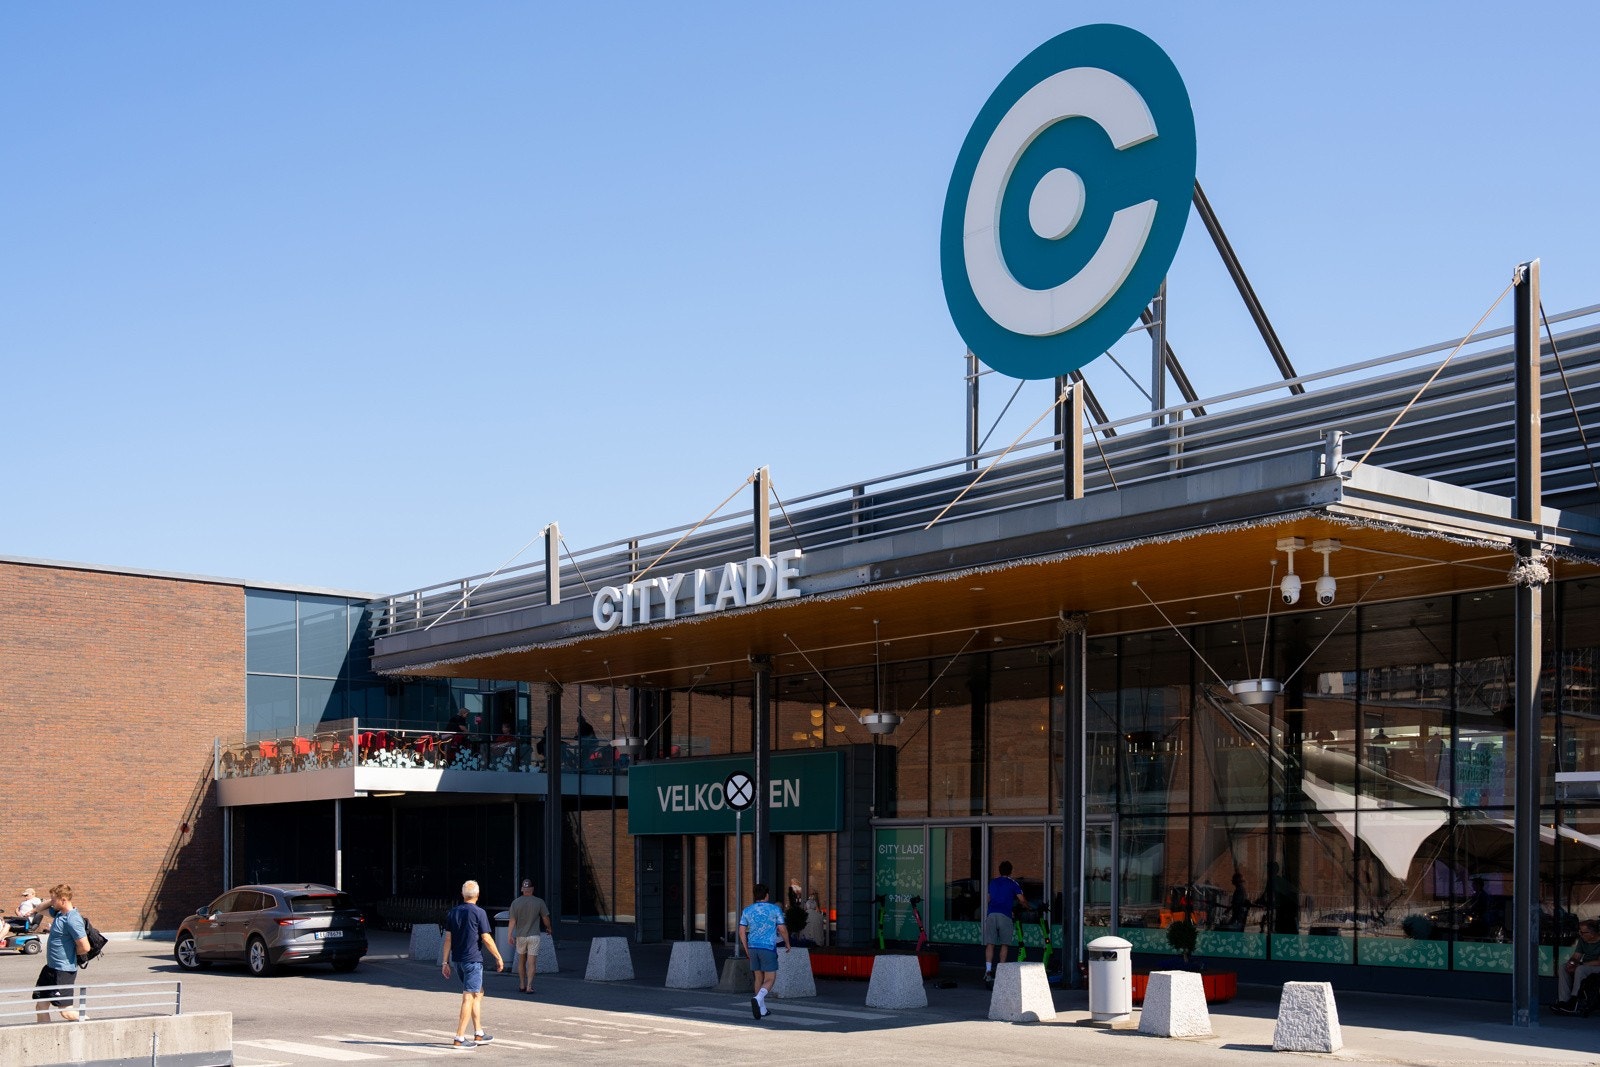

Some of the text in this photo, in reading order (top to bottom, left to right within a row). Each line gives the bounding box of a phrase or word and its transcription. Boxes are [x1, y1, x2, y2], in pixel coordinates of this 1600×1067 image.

[593, 549, 802, 632] CITY LADE
[657, 778, 800, 812] VELKOEN
[878, 844, 924, 854] CITY LADE
